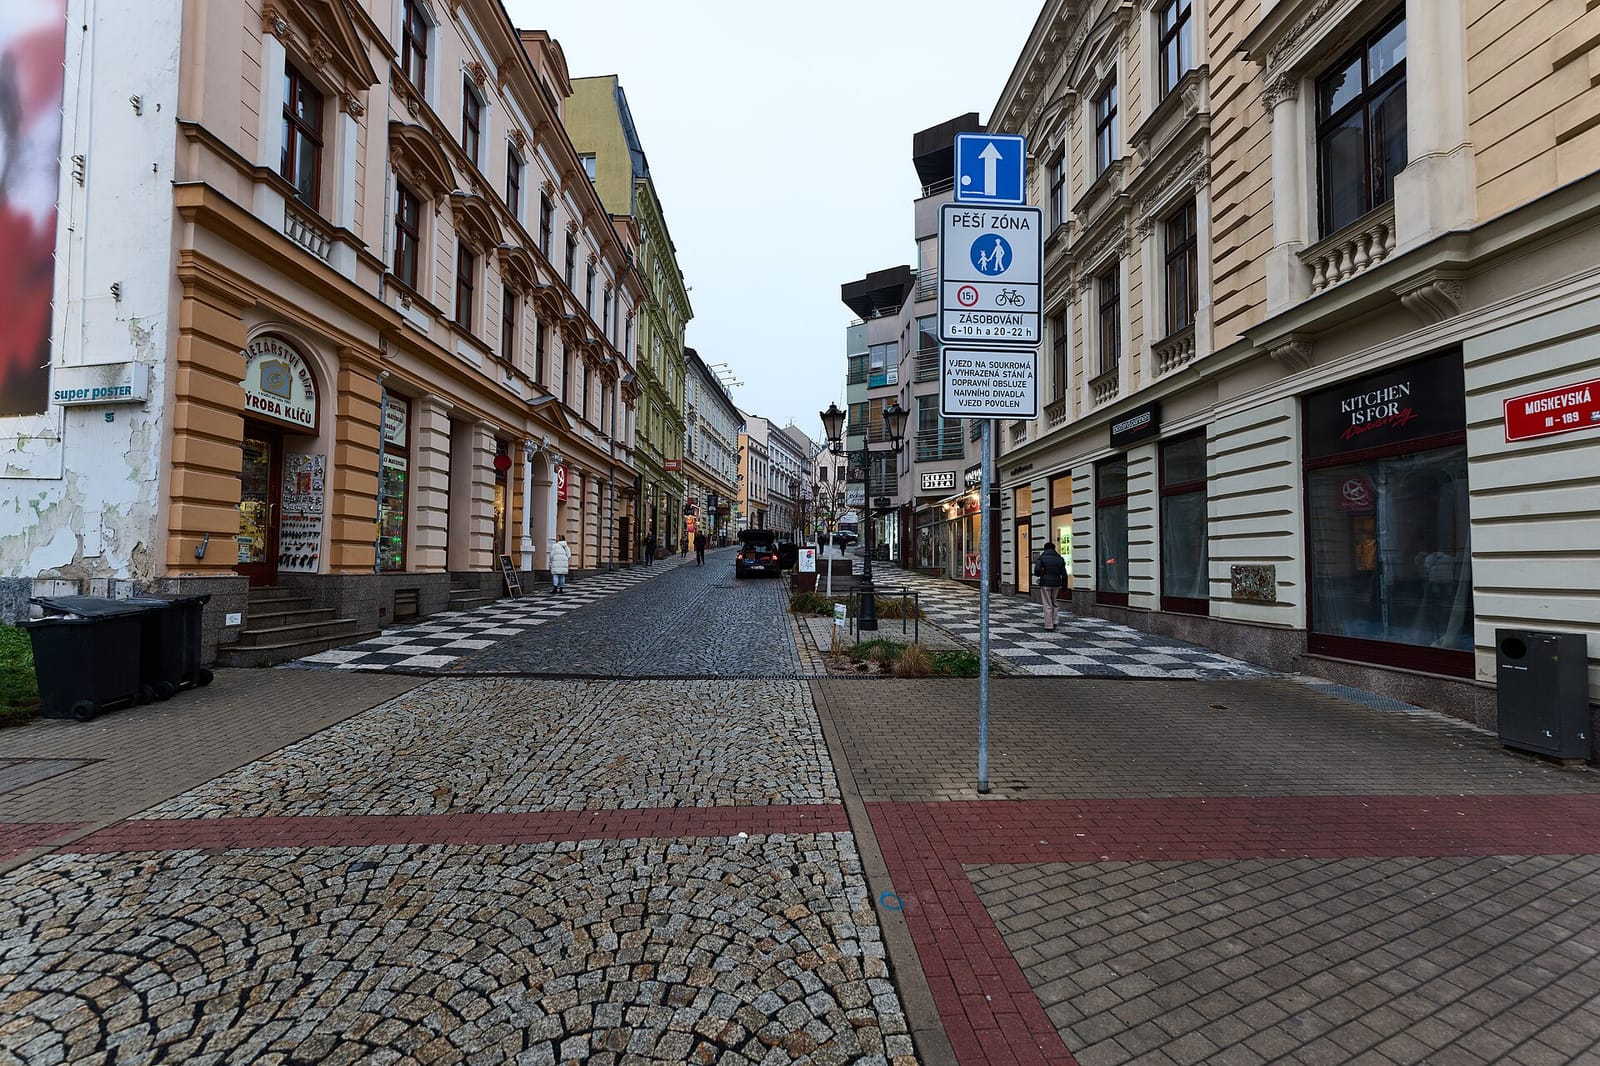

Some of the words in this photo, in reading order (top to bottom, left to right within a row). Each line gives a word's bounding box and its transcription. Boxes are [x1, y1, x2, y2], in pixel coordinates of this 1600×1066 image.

[952, 212, 986, 228] PĚŠÍ
[991, 214, 1030, 230] ZÓNA
[960, 312, 1024, 325] ZÁSOBOVÁNÍ
[976, 326, 982, 335] h
[1026, 328, 1032, 337] h
[243, 338, 300, 367] LEZÁŘSTVÍ
[989, 361, 1031, 369] SOUKROMÁ
[956, 369, 1000, 377] VYHRAZENÁ
[1002, 370, 1025, 378] STÁNÍ
[952, 378, 990, 387] DOPRAVNÍ
[54, 388, 89, 401] super
[954, 388, 990, 397] NAIVNÍHO
[1341, 382, 1410, 412] KITCHEN
[245, 390, 282, 416] ÝROBA
[284, 406, 312, 424] KLÍČŮ
[1525, 387, 1592, 415] MOSKEVSKÁ
[1352, 410, 1364, 425] IS
[1366, 402, 1400, 422] FOR
